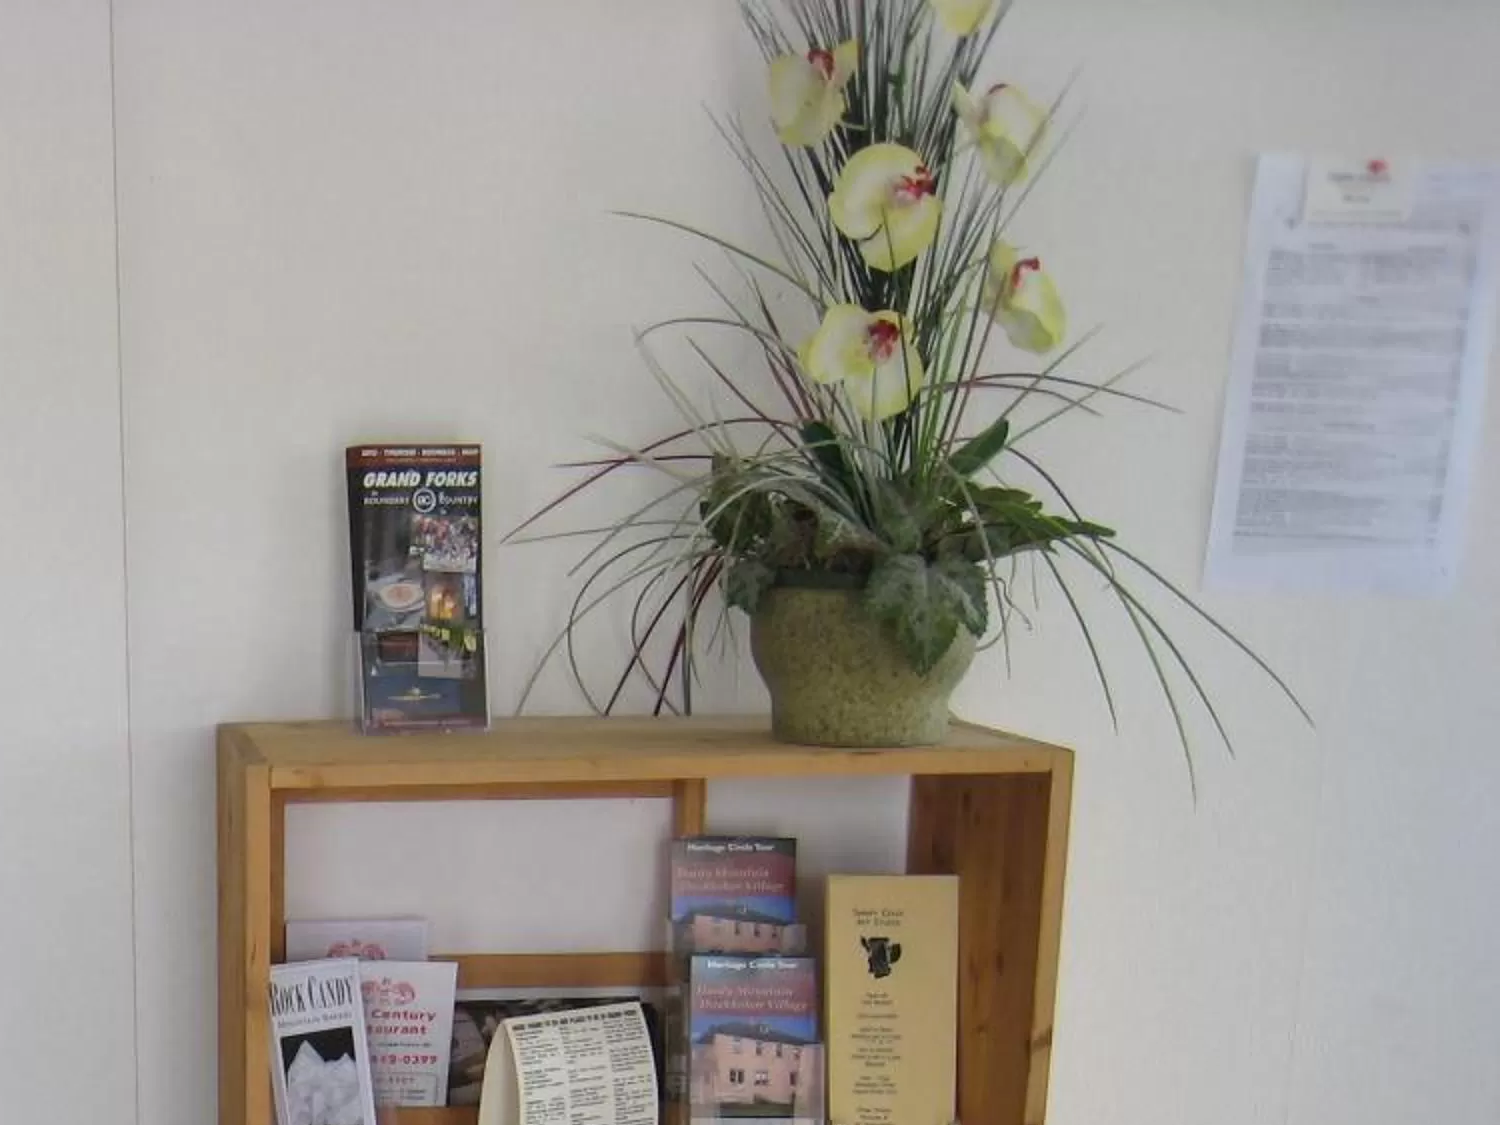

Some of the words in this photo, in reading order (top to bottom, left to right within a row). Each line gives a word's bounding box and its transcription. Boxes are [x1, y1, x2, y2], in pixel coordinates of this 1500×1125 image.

[363, 470, 421, 488] GRAND
[425, 471, 478, 487] FORKS
[307, 975, 355, 1009] CANDY
[371, 1008, 437, 1022] Century
